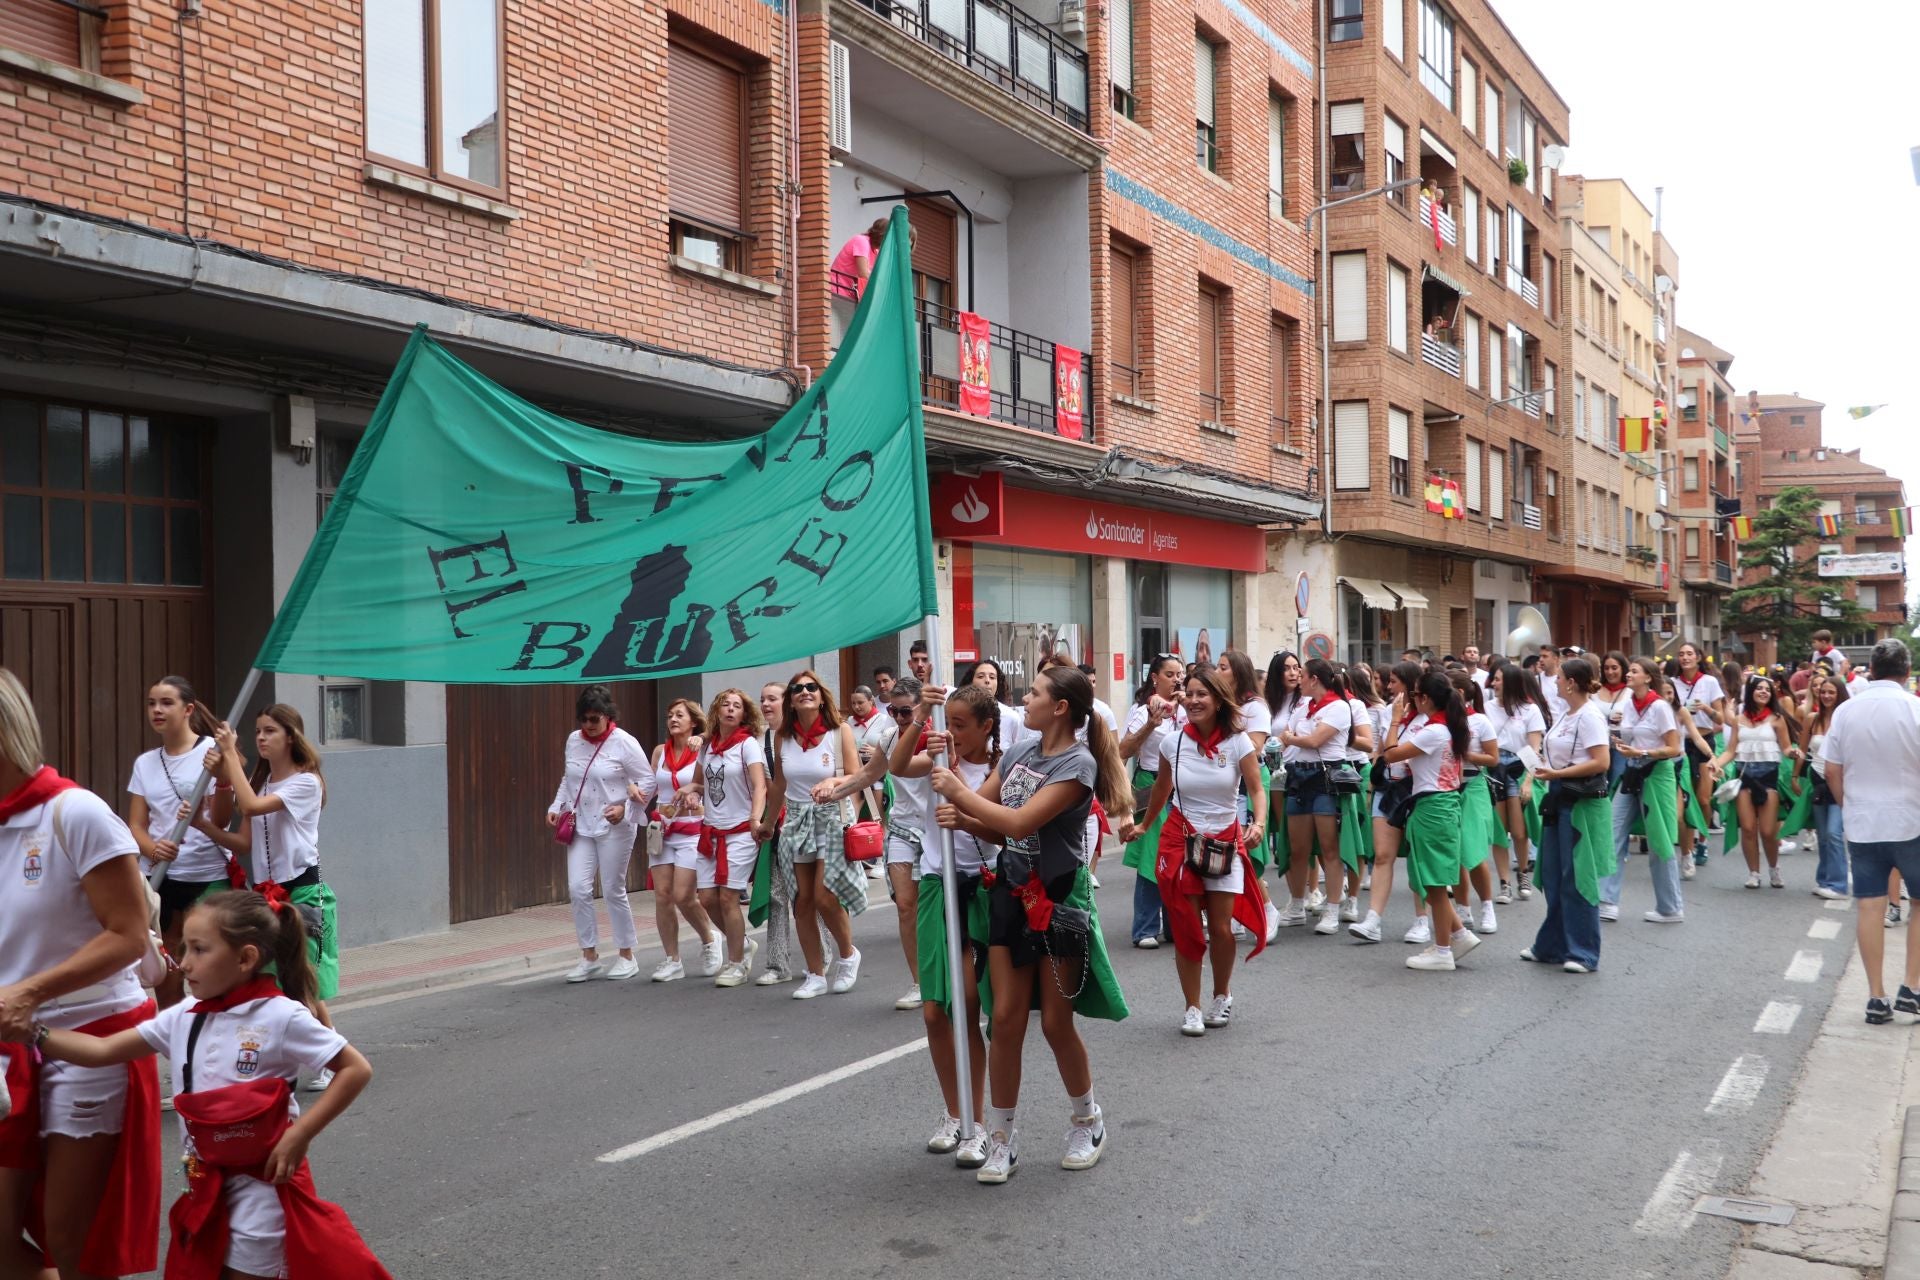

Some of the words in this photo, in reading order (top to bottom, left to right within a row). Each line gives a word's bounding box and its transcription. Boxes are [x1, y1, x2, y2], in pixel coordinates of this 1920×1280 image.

[427, 530, 527, 639] EL
[497, 450, 876, 671] BUREO
[1099, 517, 1145, 545] Santander
[1153, 530, 1178, 551] Agentes
